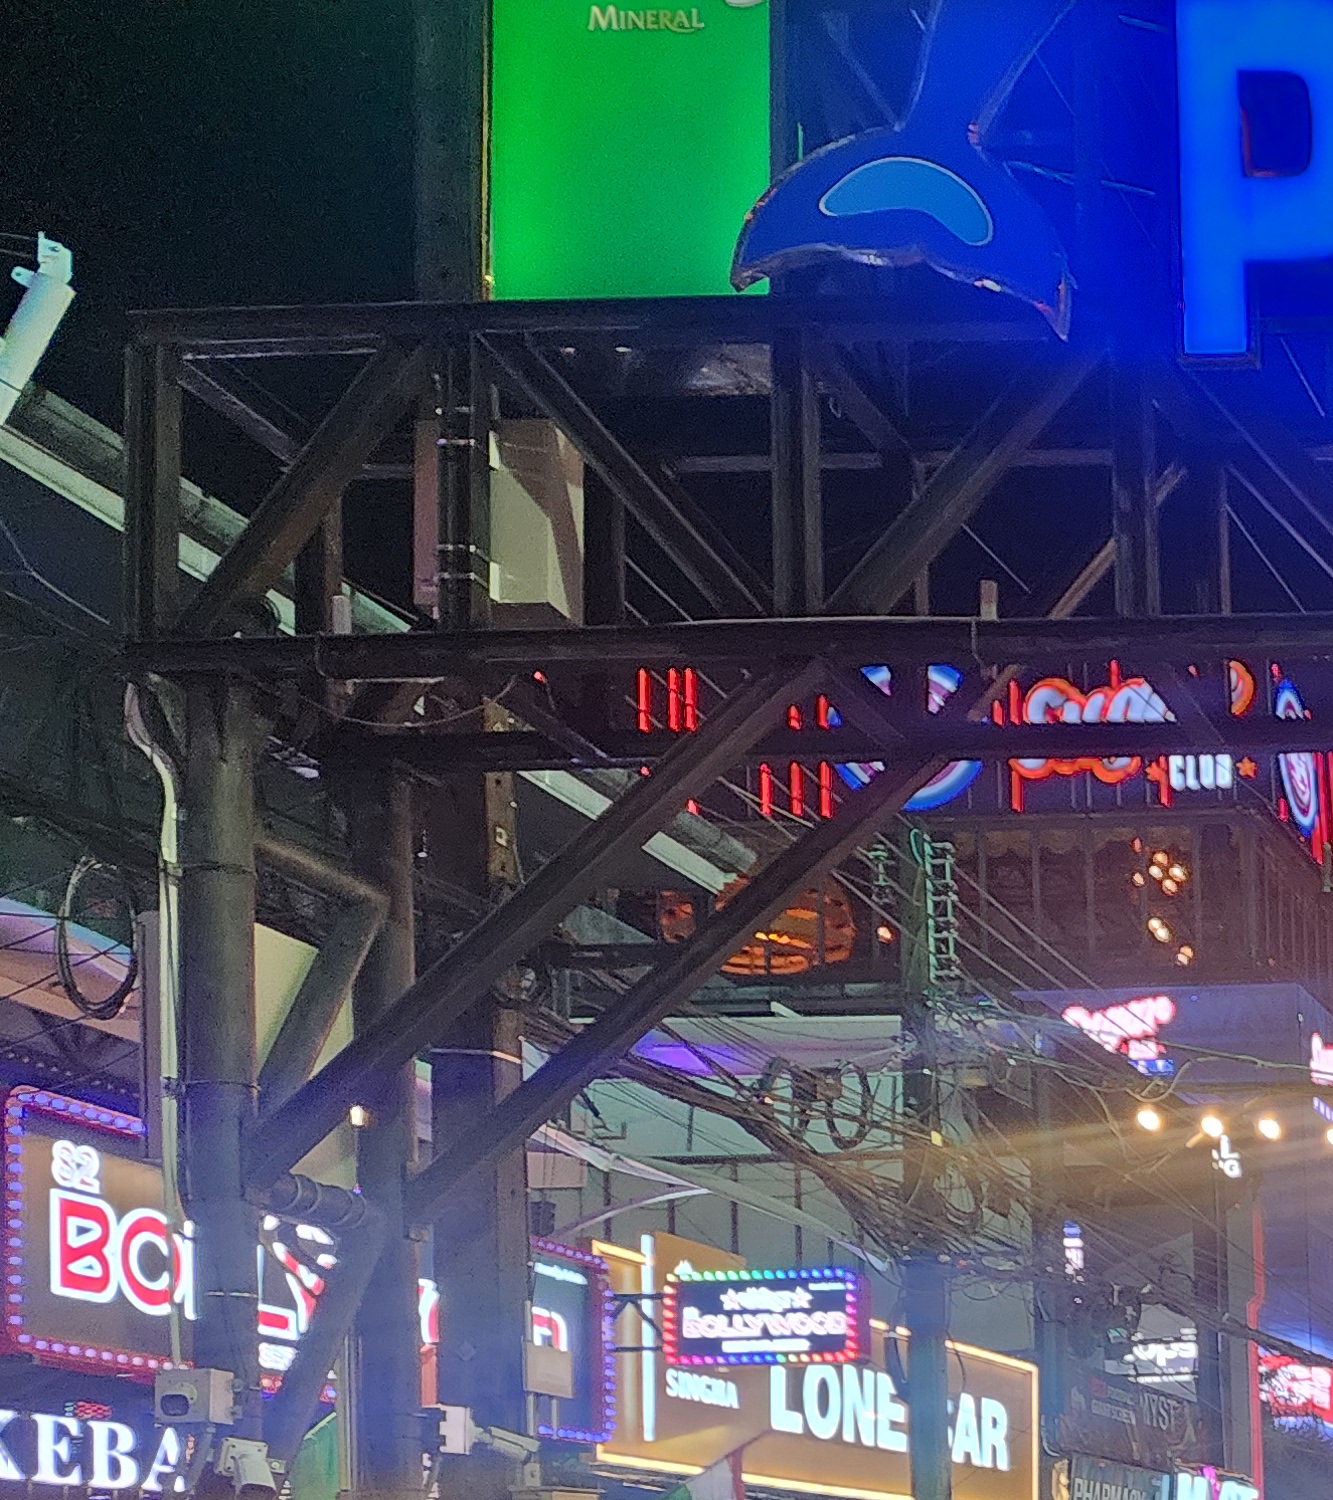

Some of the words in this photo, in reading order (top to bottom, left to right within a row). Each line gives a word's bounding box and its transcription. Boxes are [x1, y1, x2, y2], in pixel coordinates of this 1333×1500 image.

[683, 1306, 848, 1338] BOLLYWOOD
[770, 1364, 909, 1453] LONE
[946, 1392, 1011, 1472] AR
